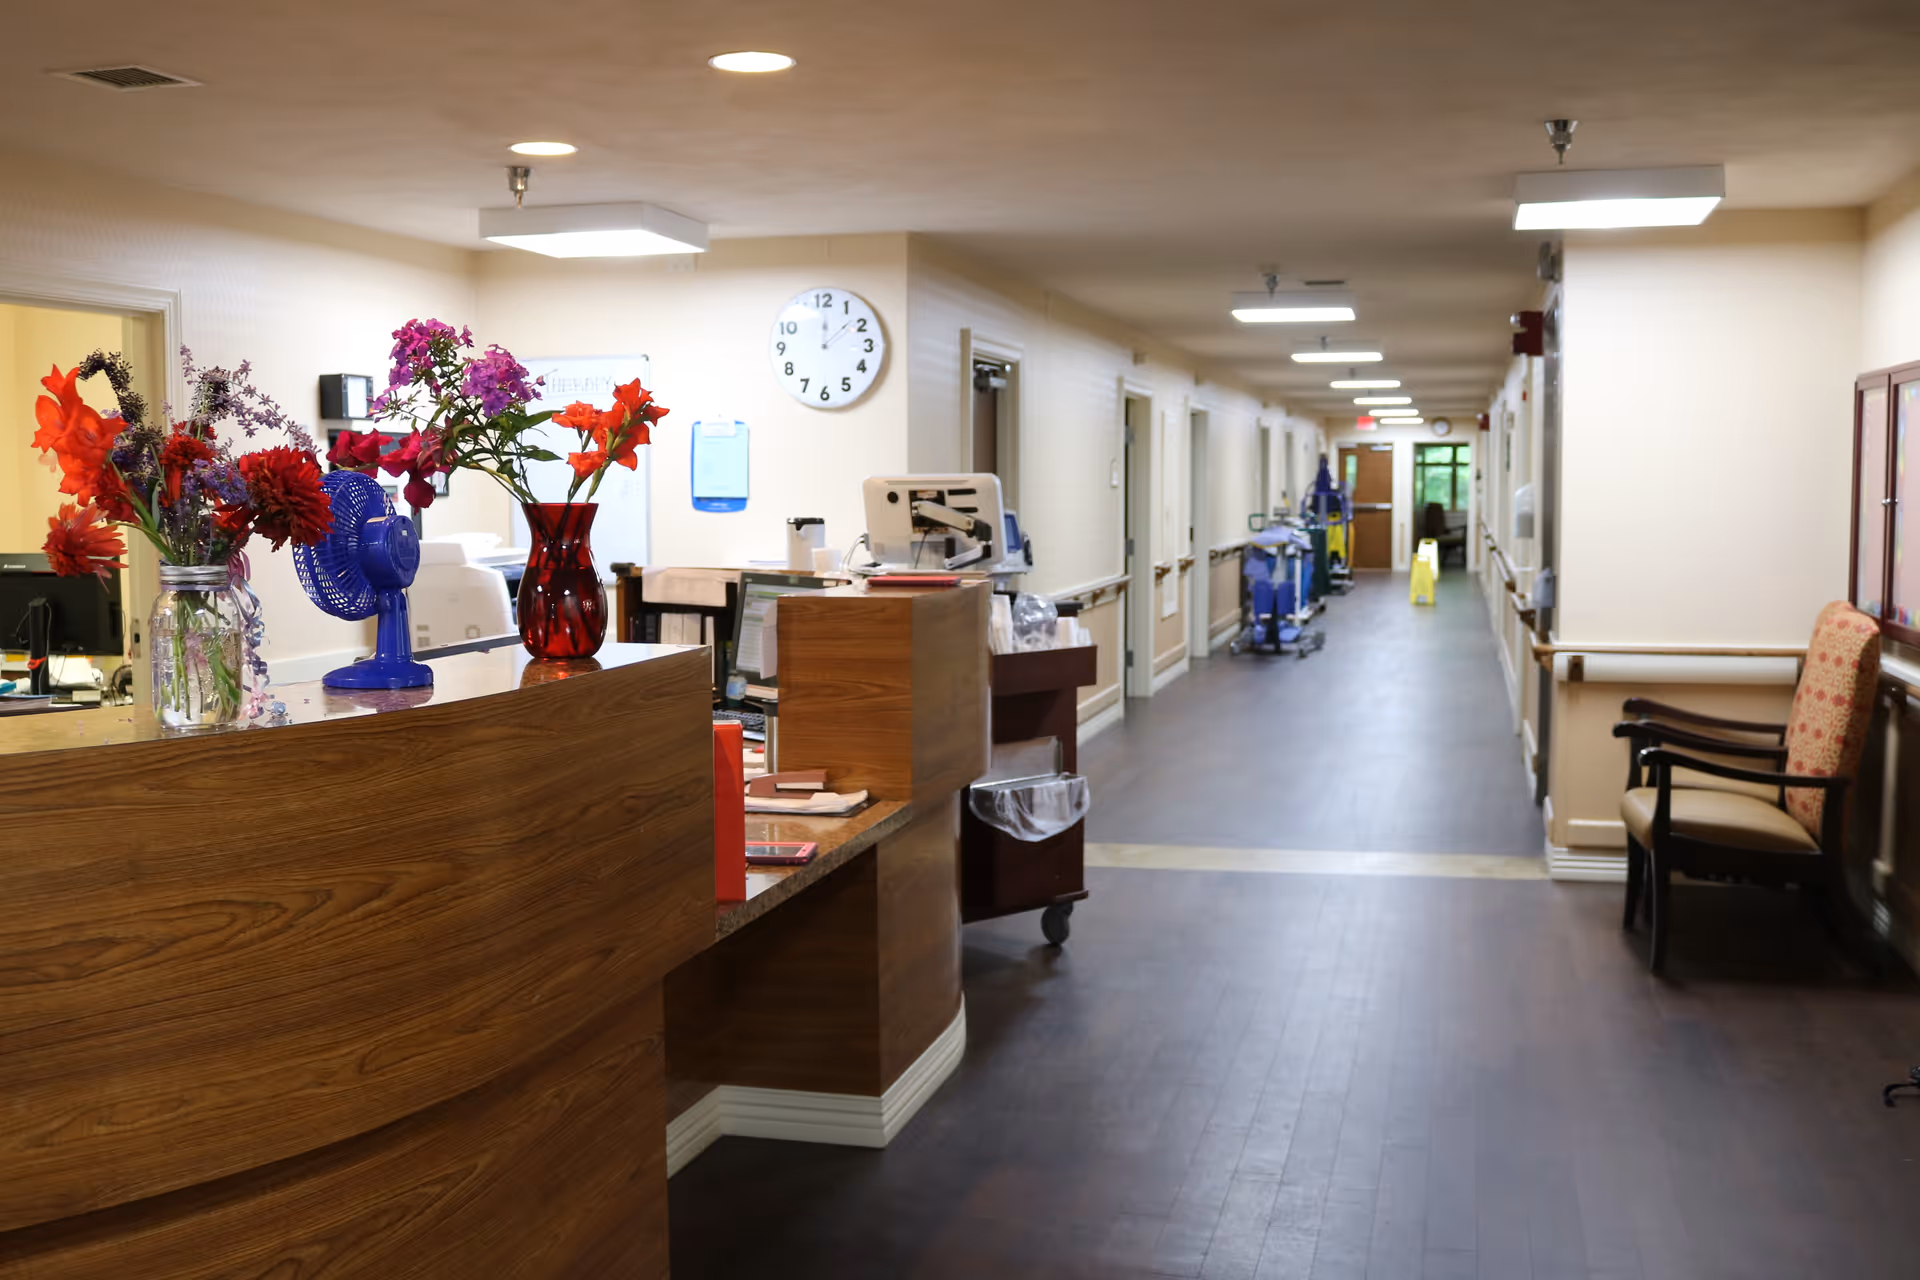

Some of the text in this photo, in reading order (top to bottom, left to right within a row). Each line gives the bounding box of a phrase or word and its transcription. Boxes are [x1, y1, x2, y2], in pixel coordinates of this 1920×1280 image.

[814, 293, 833, 308] 12
[843, 300, 849, 315] 1
[779, 321, 798, 335] 10
[856, 318, 867, 333] 2
[776, 341, 786, 356] 9
[864, 338, 874, 353] 3
[784, 361, 794, 376] 8
[856, 358, 867, 374] 4
[800, 377, 810, 393] 7
[841, 377, 851, 392] 5
[820, 385, 830, 401] 6
